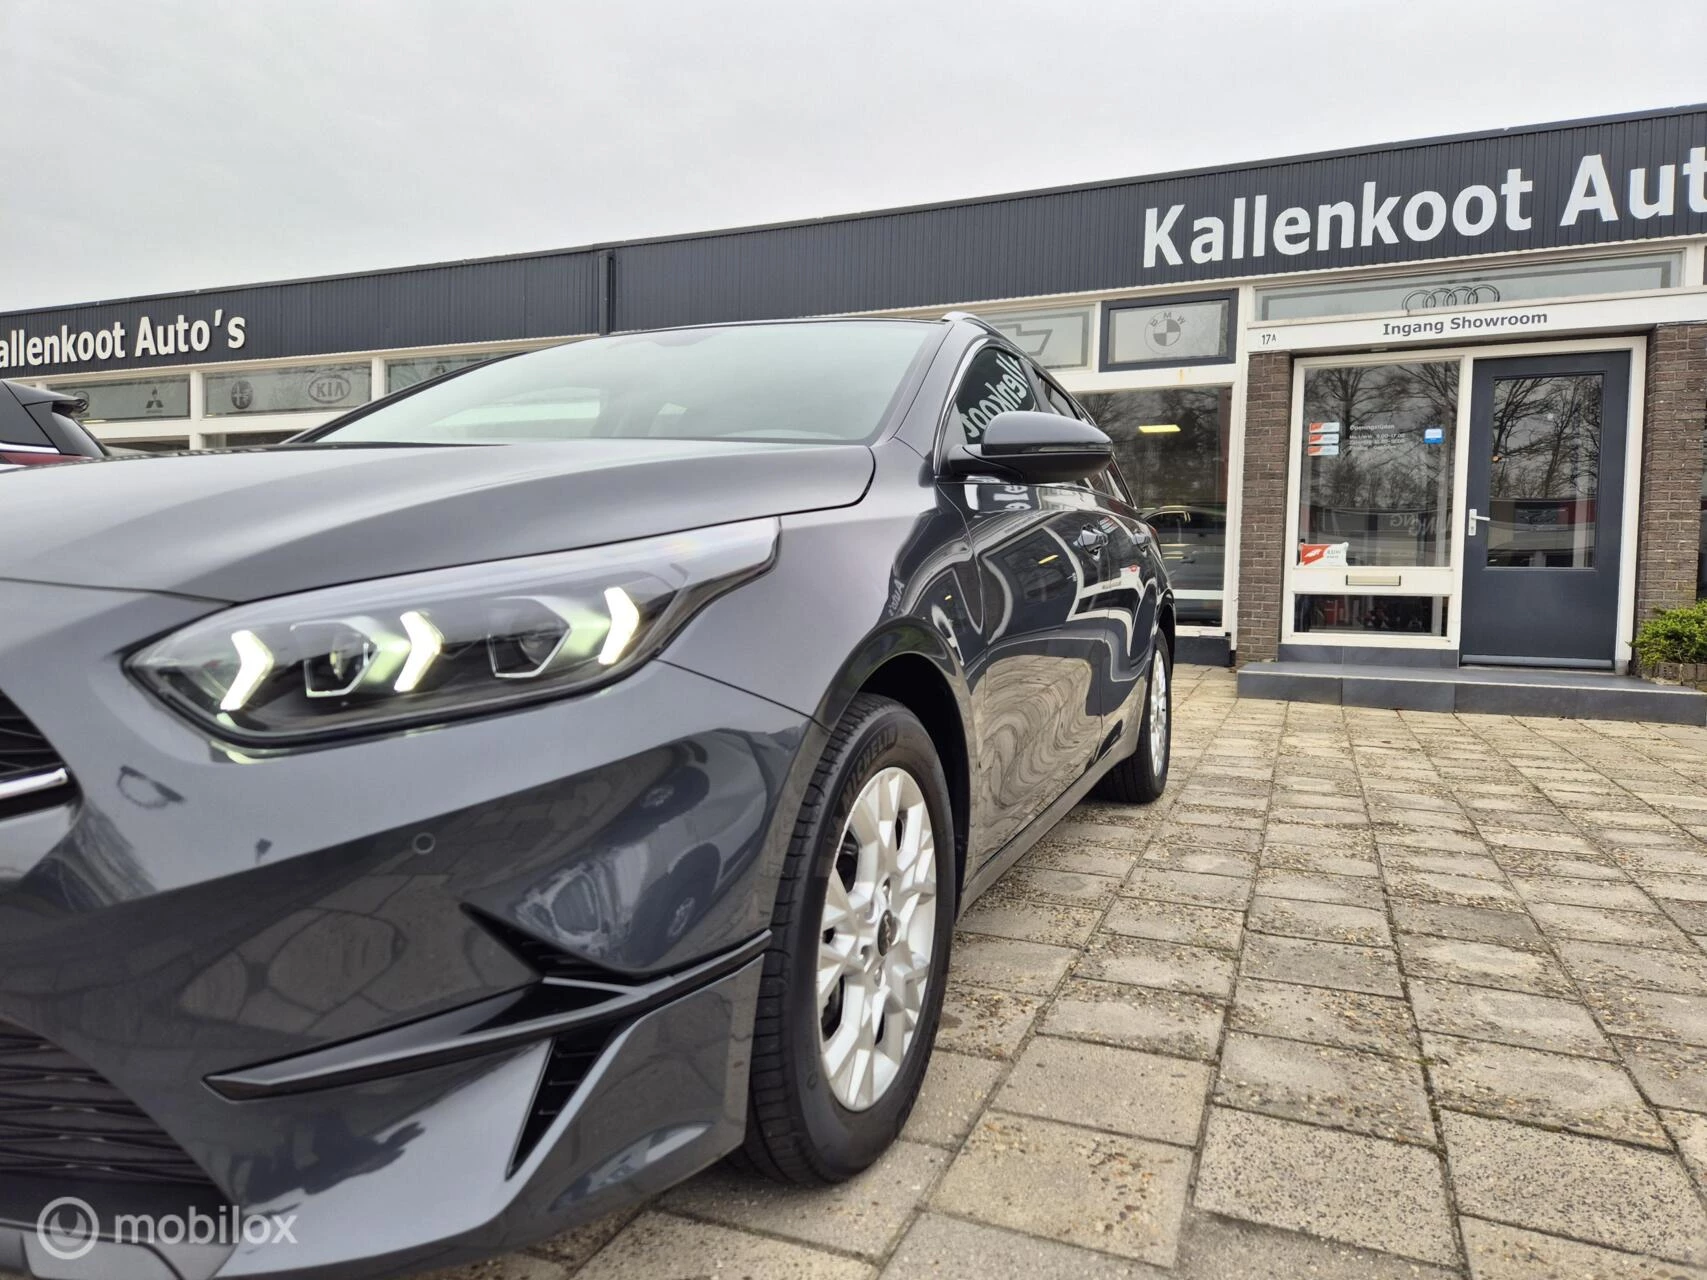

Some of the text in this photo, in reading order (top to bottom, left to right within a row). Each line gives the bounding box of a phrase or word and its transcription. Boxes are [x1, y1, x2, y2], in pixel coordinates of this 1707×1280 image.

[1143, 146, 1707, 268] Kallenkoot Aut
[134, 309, 246, 357] Auto's
[1383, 313, 1548, 337] Ingang Showroom
